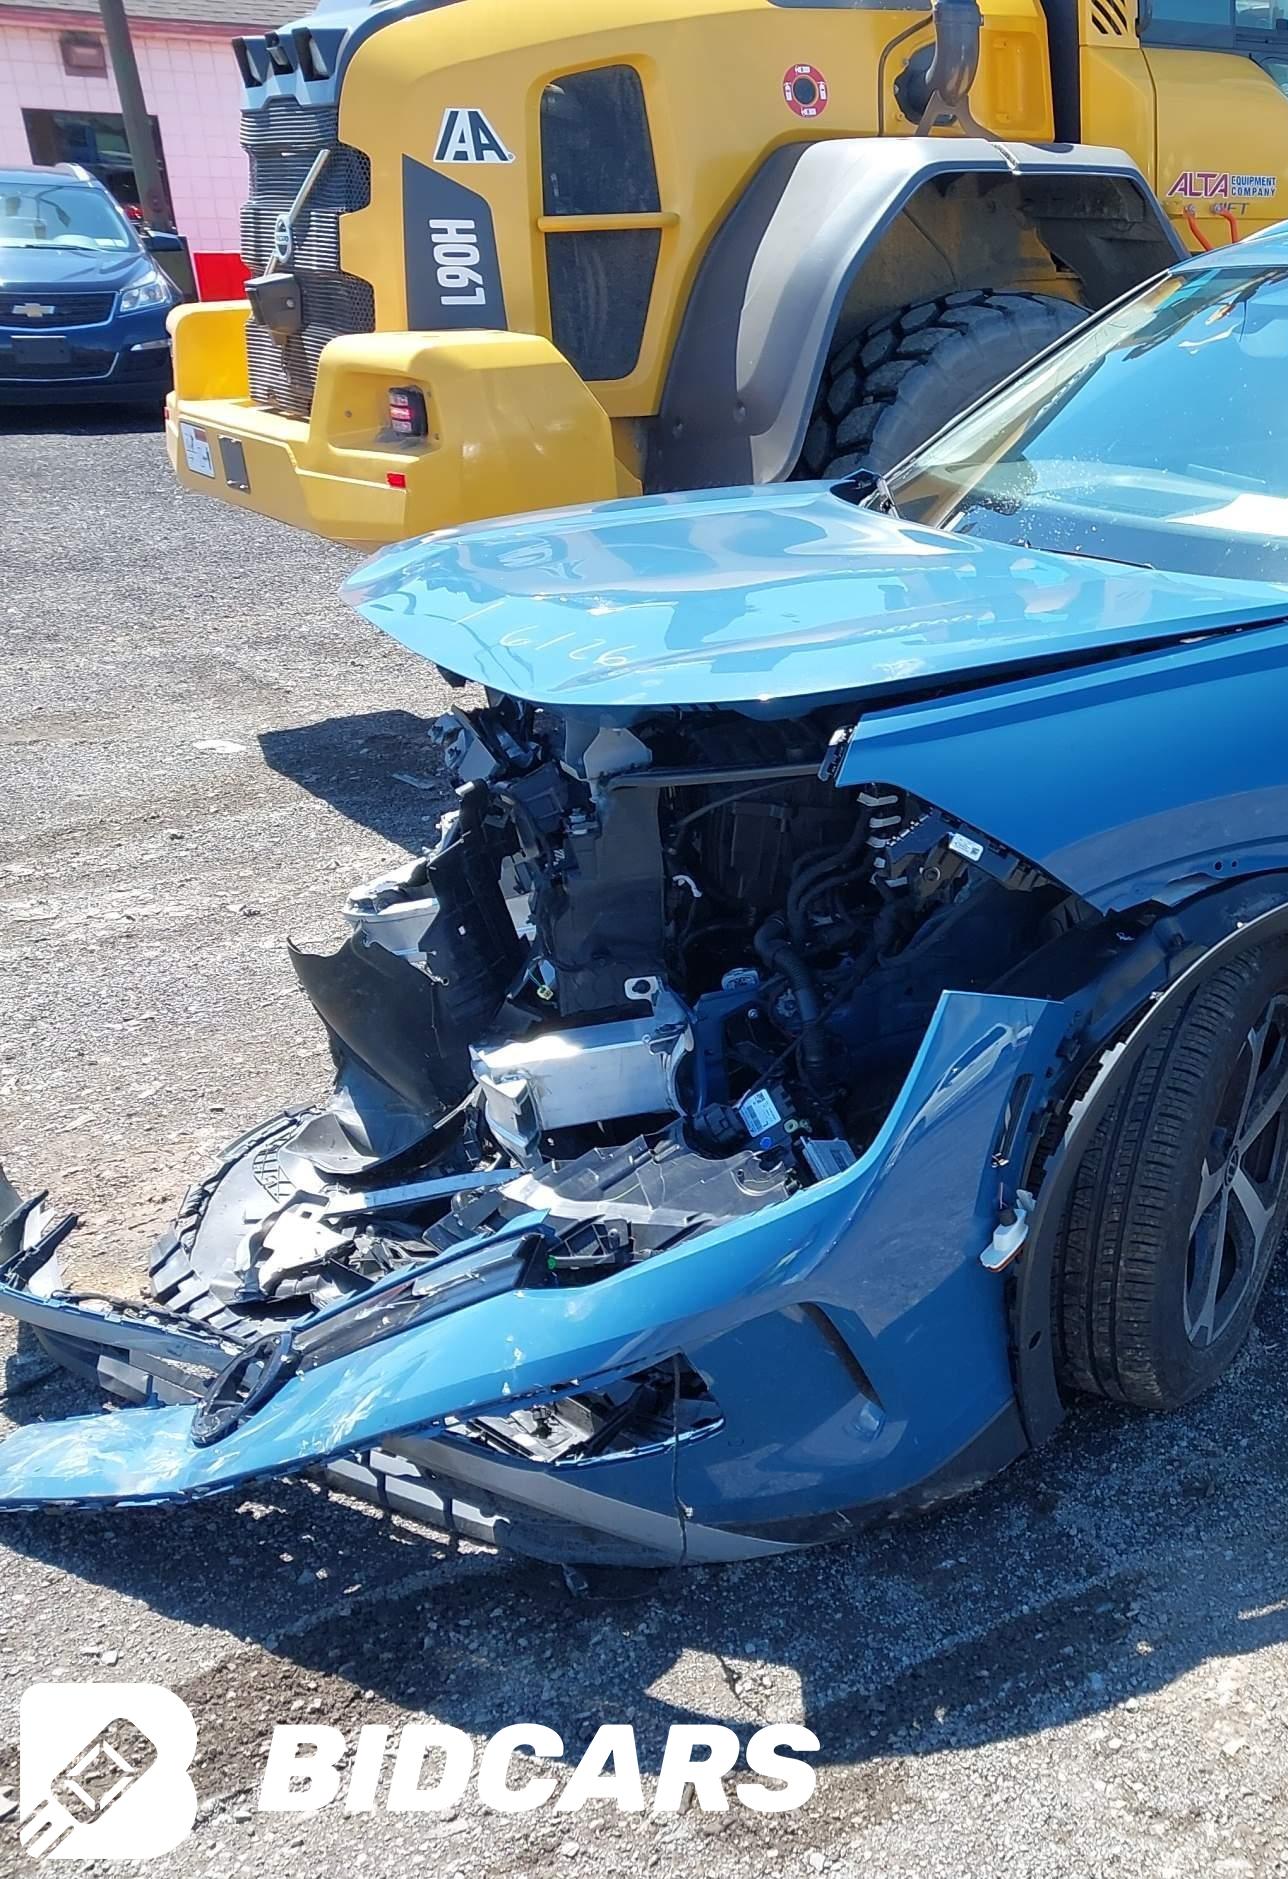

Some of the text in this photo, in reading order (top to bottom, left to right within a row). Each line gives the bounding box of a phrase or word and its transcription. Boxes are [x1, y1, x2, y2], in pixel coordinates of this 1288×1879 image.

[1166, 171, 1229, 198] ALTA
[1231, 175, 1277, 186] EQUIPMENT
[1231, 186, 1275, 197] COMPANY
[429, 219, 486, 305] L90H
